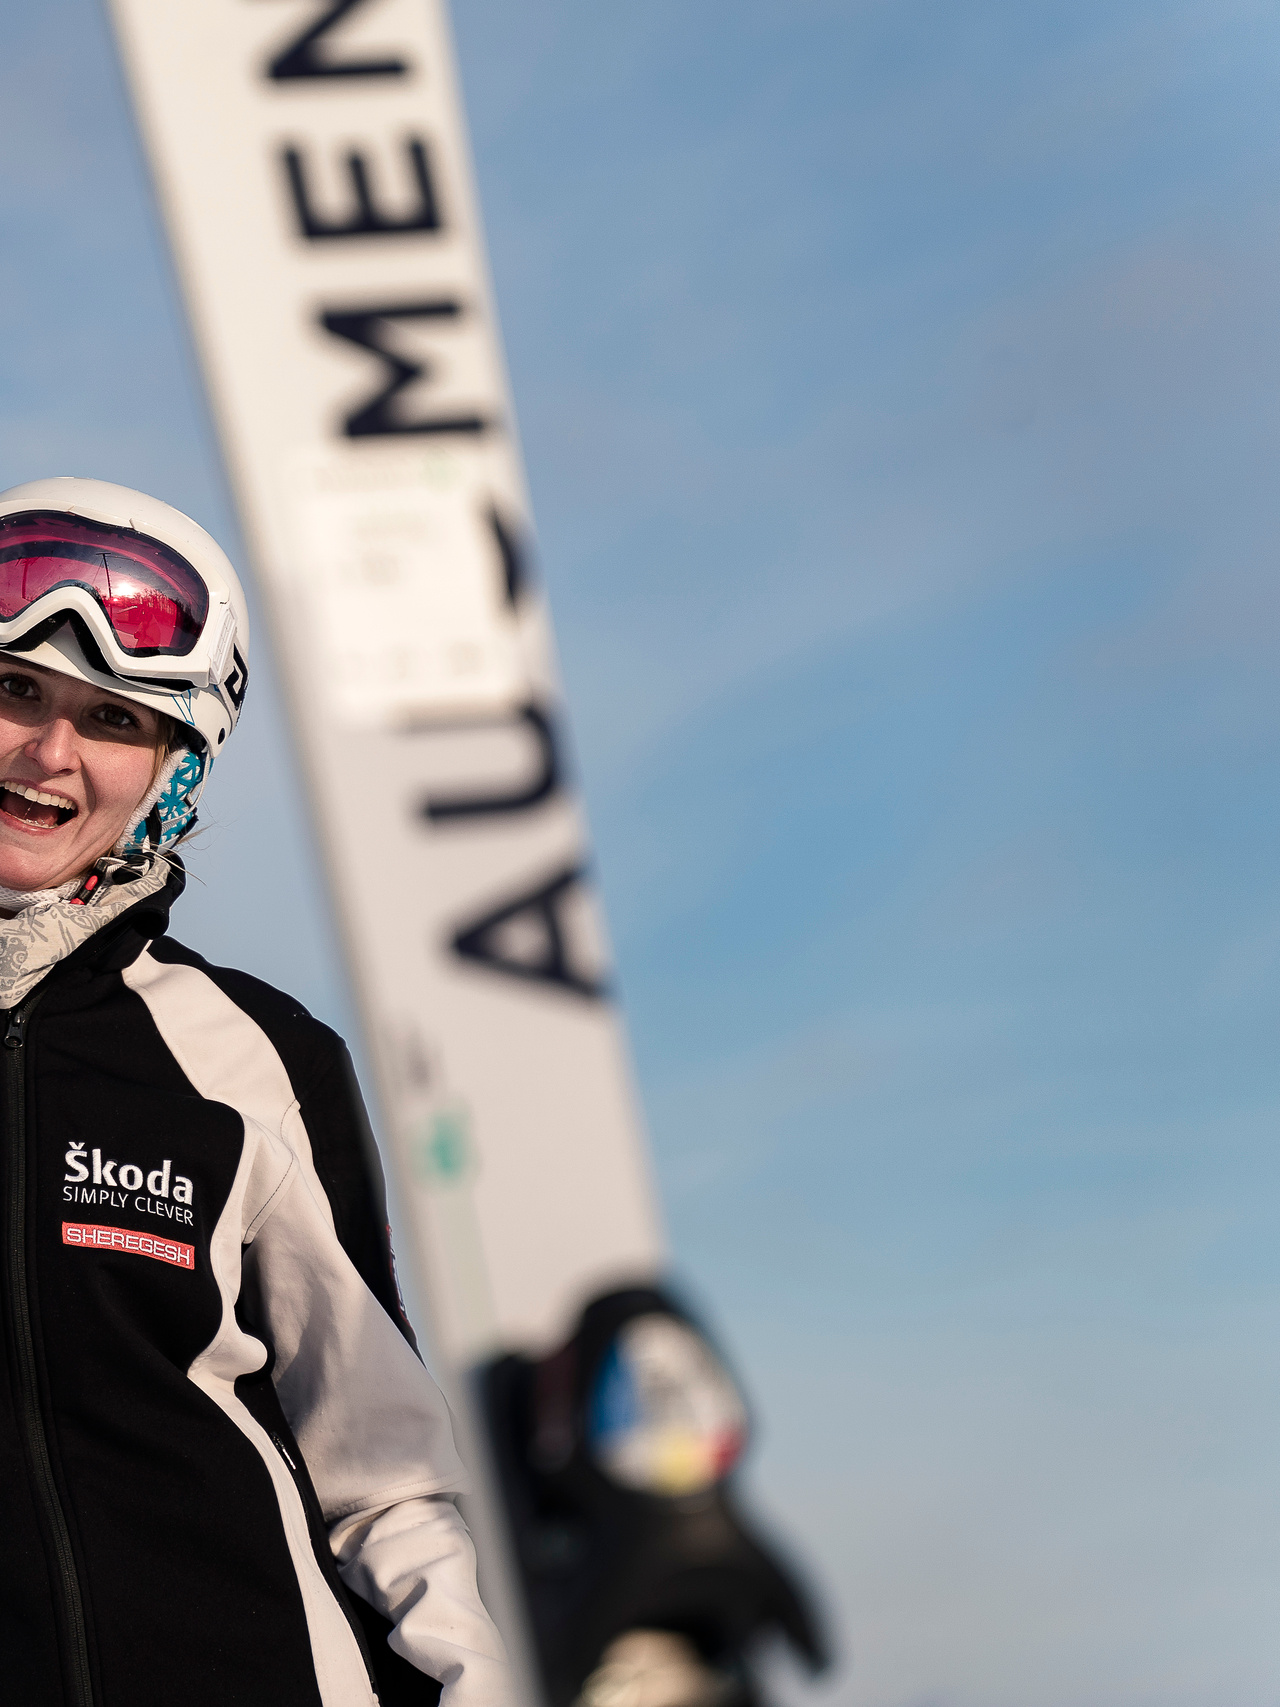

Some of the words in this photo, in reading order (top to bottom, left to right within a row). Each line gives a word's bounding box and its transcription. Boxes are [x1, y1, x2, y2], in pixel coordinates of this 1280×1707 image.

[263, 0, 612, 1005] AUMEN
[63, 1141, 194, 1206] Škoda
[62, 1185, 129, 1209] SIMPLY
[134, 1196, 195, 1227] CLEVER
[66, 1226, 191, 1266] SHEREGESH
